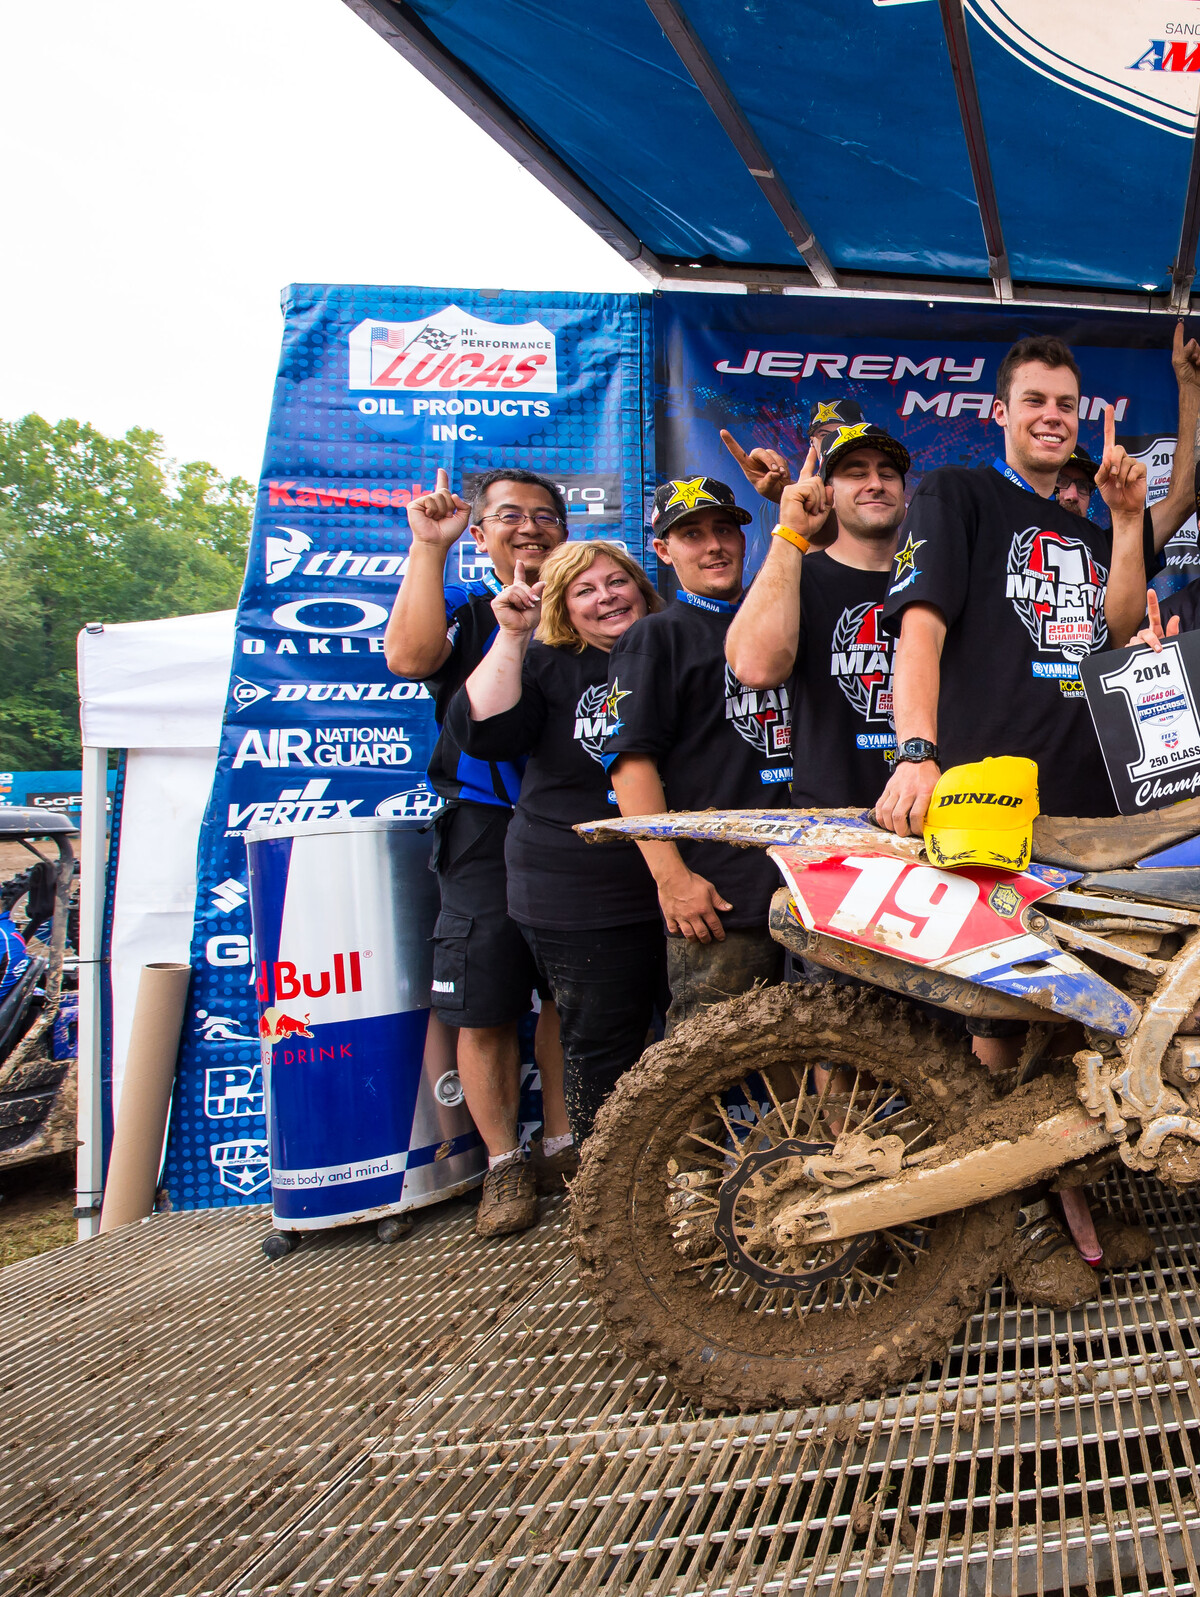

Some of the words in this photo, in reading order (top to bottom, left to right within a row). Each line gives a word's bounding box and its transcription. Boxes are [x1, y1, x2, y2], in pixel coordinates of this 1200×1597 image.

[460, 328, 478, 337] HI-
[460, 339, 552, 350] PERFORMANCE
[371, 352, 547, 389] LUCAS
[715, 350, 985, 382] JEREMY
[358, 398, 404, 416] OIL
[413, 399, 551, 418] PRODUCTS
[902, 390, 1129, 422] MAIN
[432, 425, 484, 442] INC.
[269, 481, 437, 508] Kawasak
[302, 550, 410, 576] tho
[693, 595, 720, 613] YAMAHA
[1048, 624, 1074, 634] 250
[1060, 616, 1085, 624] 2014
[847, 644, 882, 652] JEREMY
[1043, 664, 1078, 676] YAMAHA
[1133, 662, 1171, 684] 2014
[1142, 691, 1163, 704] LUCAS
[1165, 689, 1175, 698] OIL
[1140, 699, 1185, 717] MOTOCROSS
[316, 727, 409, 743] NATIONAL
[232, 728, 313, 769] AIR
[314, 744, 412, 767] GUARD
[1149, 755, 1168, 768] 250
[1171, 745, 1200, 762] CLASS
[938, 792, 1023, 809] DUNLOP
[227, 799, 364, 829] VERTEX
[828, 855, 980, 961] 19
[284, 1043, 353, 1065] DRINK
[298, 1172, 325, 1186] body
[328, 1167, 352, 1182] and
[355, 1160, 393, 1177] mind.
